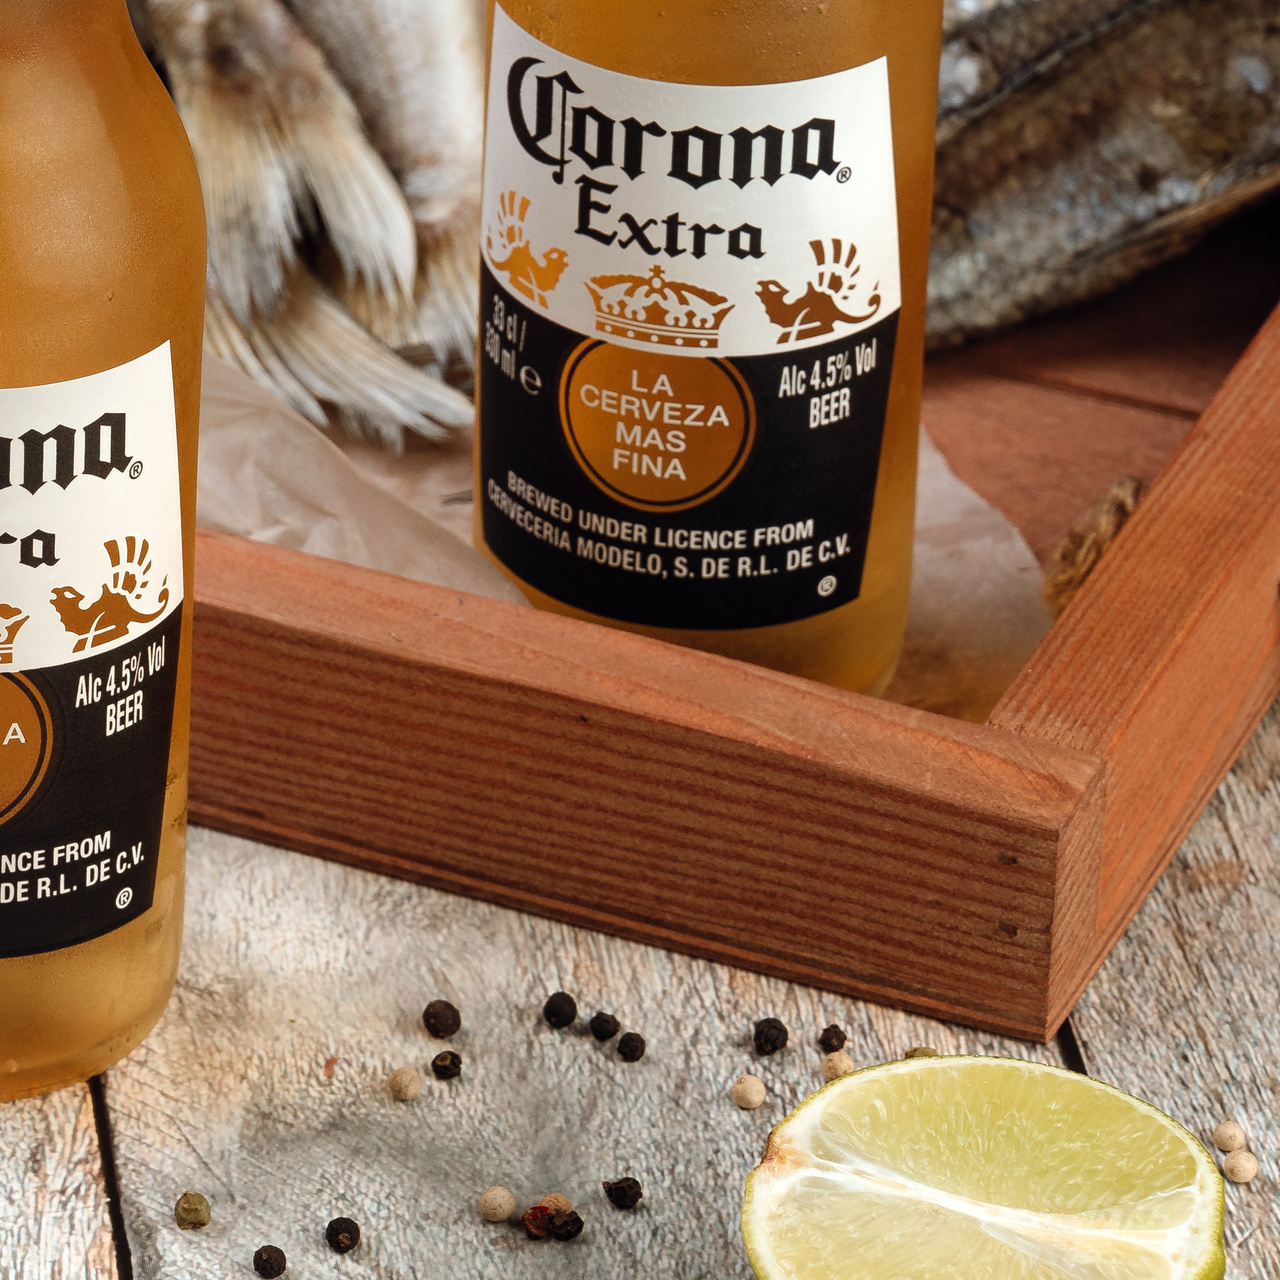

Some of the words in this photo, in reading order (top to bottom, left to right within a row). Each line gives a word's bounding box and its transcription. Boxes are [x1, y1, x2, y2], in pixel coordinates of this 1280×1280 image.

[507, 56, 840, 190] Corona
[574, 174, 766, 260] Extra
[631, 369, 674, 397] LA
[778, 364, 806, 398] Alc
[809, 350, 852, 386] 4.5%
[856, 337, 878, 375] Vol
[579, 384, 730, 428] CERVEZA
[809, 388, 851, 430] BEER
[615, 421, 687, 452] MAS
[612, 448, 687, 481] FINA
[488, 478, 572, 553] CERVECERIA
[577, 539, 668, 580] MODELO,
[674, 556, 695, 577] S.
[701, 557, 729, 578] DE
[737, 552, 779, 577] R.L.
[786, 545, 813, 572] DE
[818, 533, 852, 564] C.V.
[507, 470, 573, 523] BREWED
[578, 510, 647, 543] UNDER
[654, 526, 747, 550] LICENCE
[753, 518, 814, 548] FROM
[75, 672, 102, 709] Alc
[105, 655, 145, 694] 4.5%
[148, 634, 165, 677] Vol
[105, 689, 144, 738] BEER
[0, 879, 29, 903] DE
[36, 870, 78, 899] R.L.
[86, 857, 111, 885] DE
[115, 842, 145, 874] C.V.
[52, 830, 111, 864] FROM
